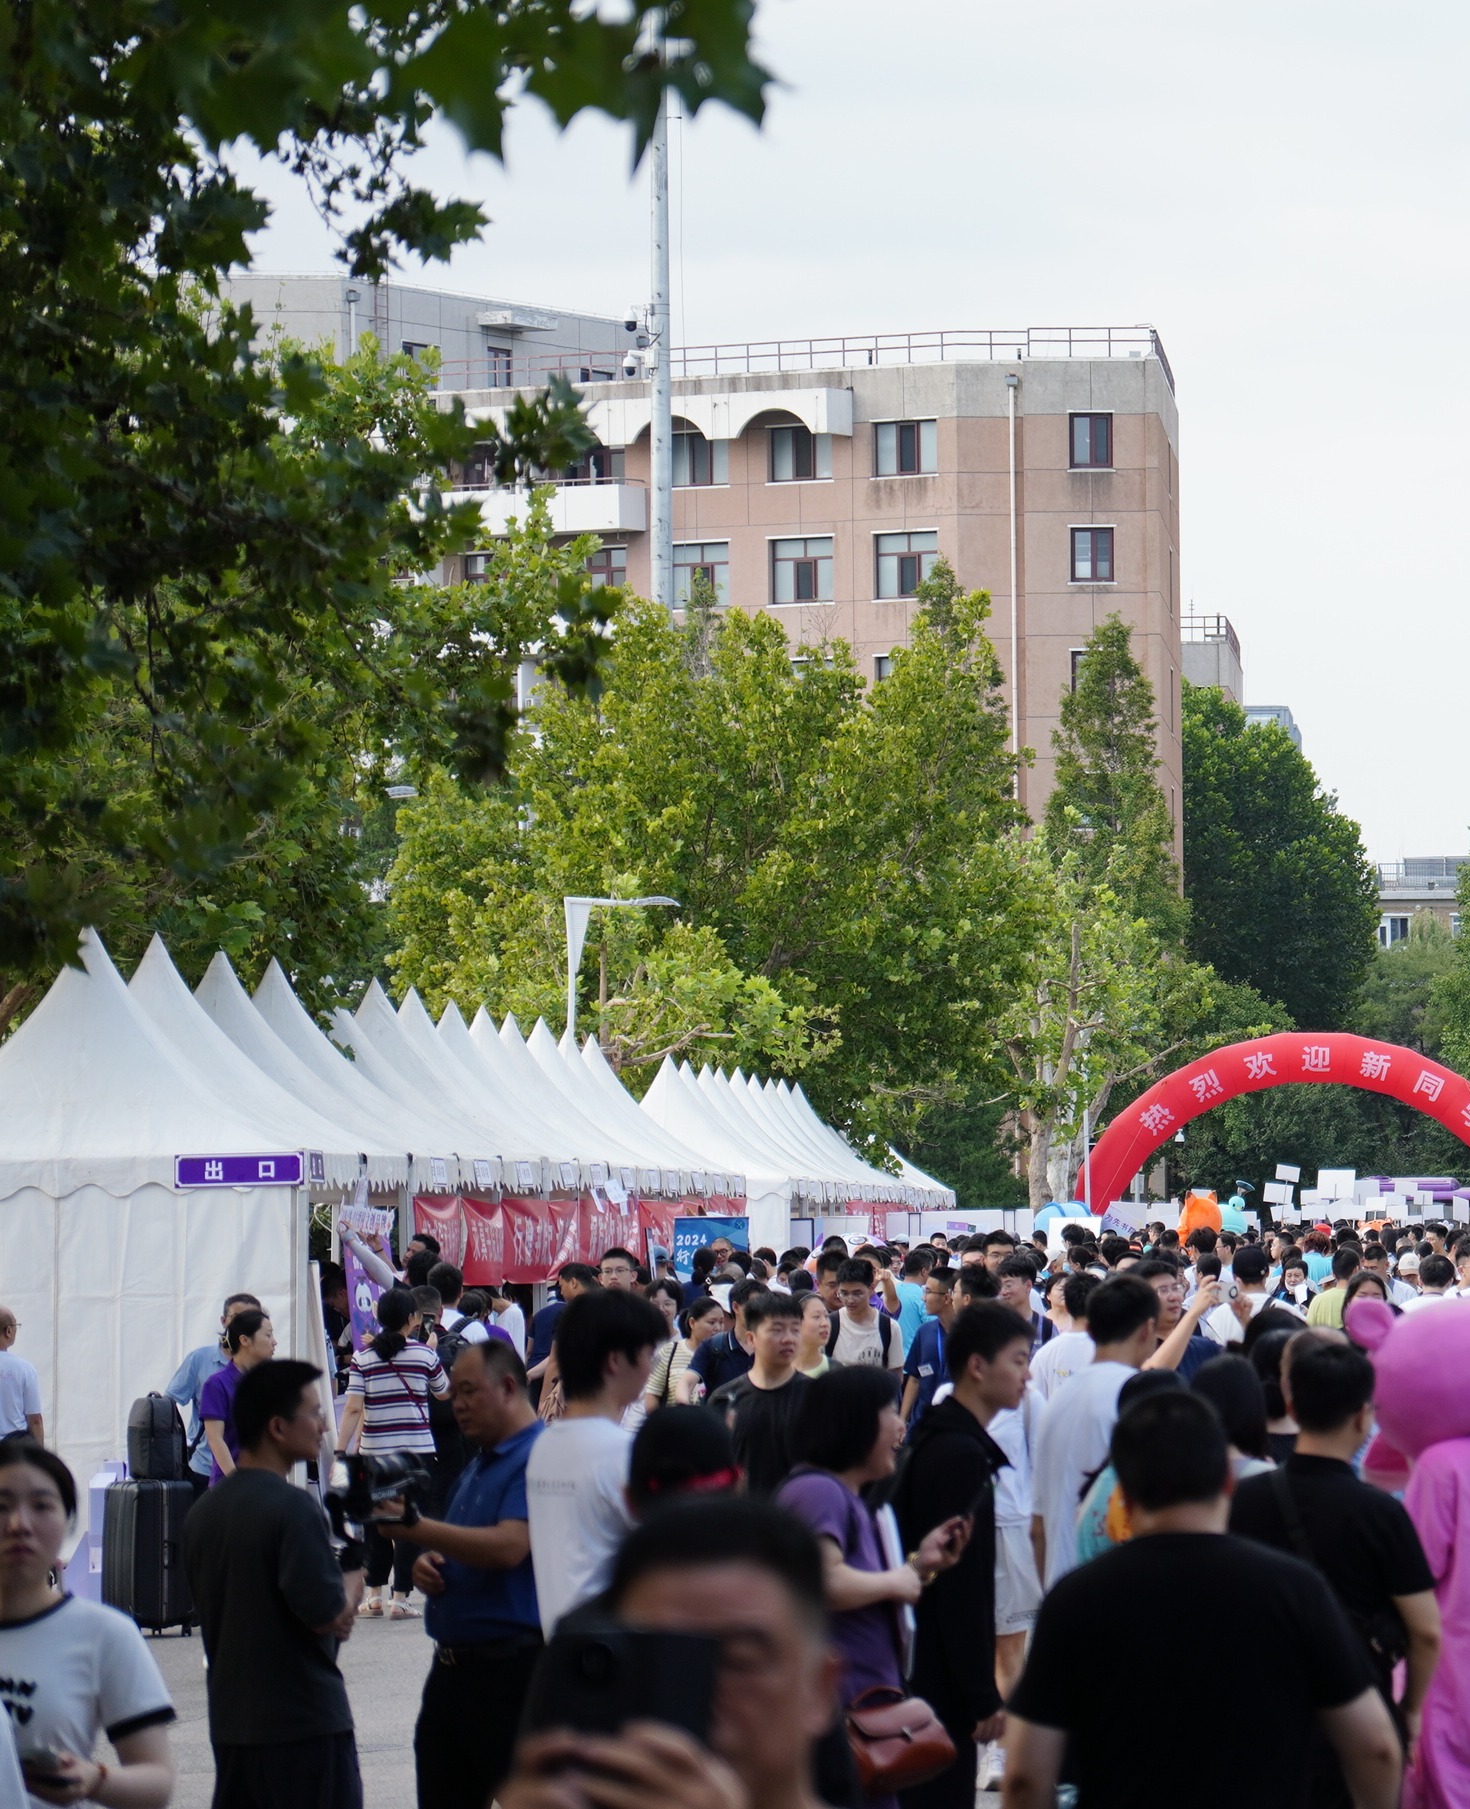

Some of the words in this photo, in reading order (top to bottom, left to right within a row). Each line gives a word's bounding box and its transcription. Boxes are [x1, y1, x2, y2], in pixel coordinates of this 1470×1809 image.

[204, 1160, 275, 1181] 出口
[676, 1234, 707, 1246] 2024
[676, 1248, 697, 1265] 行
